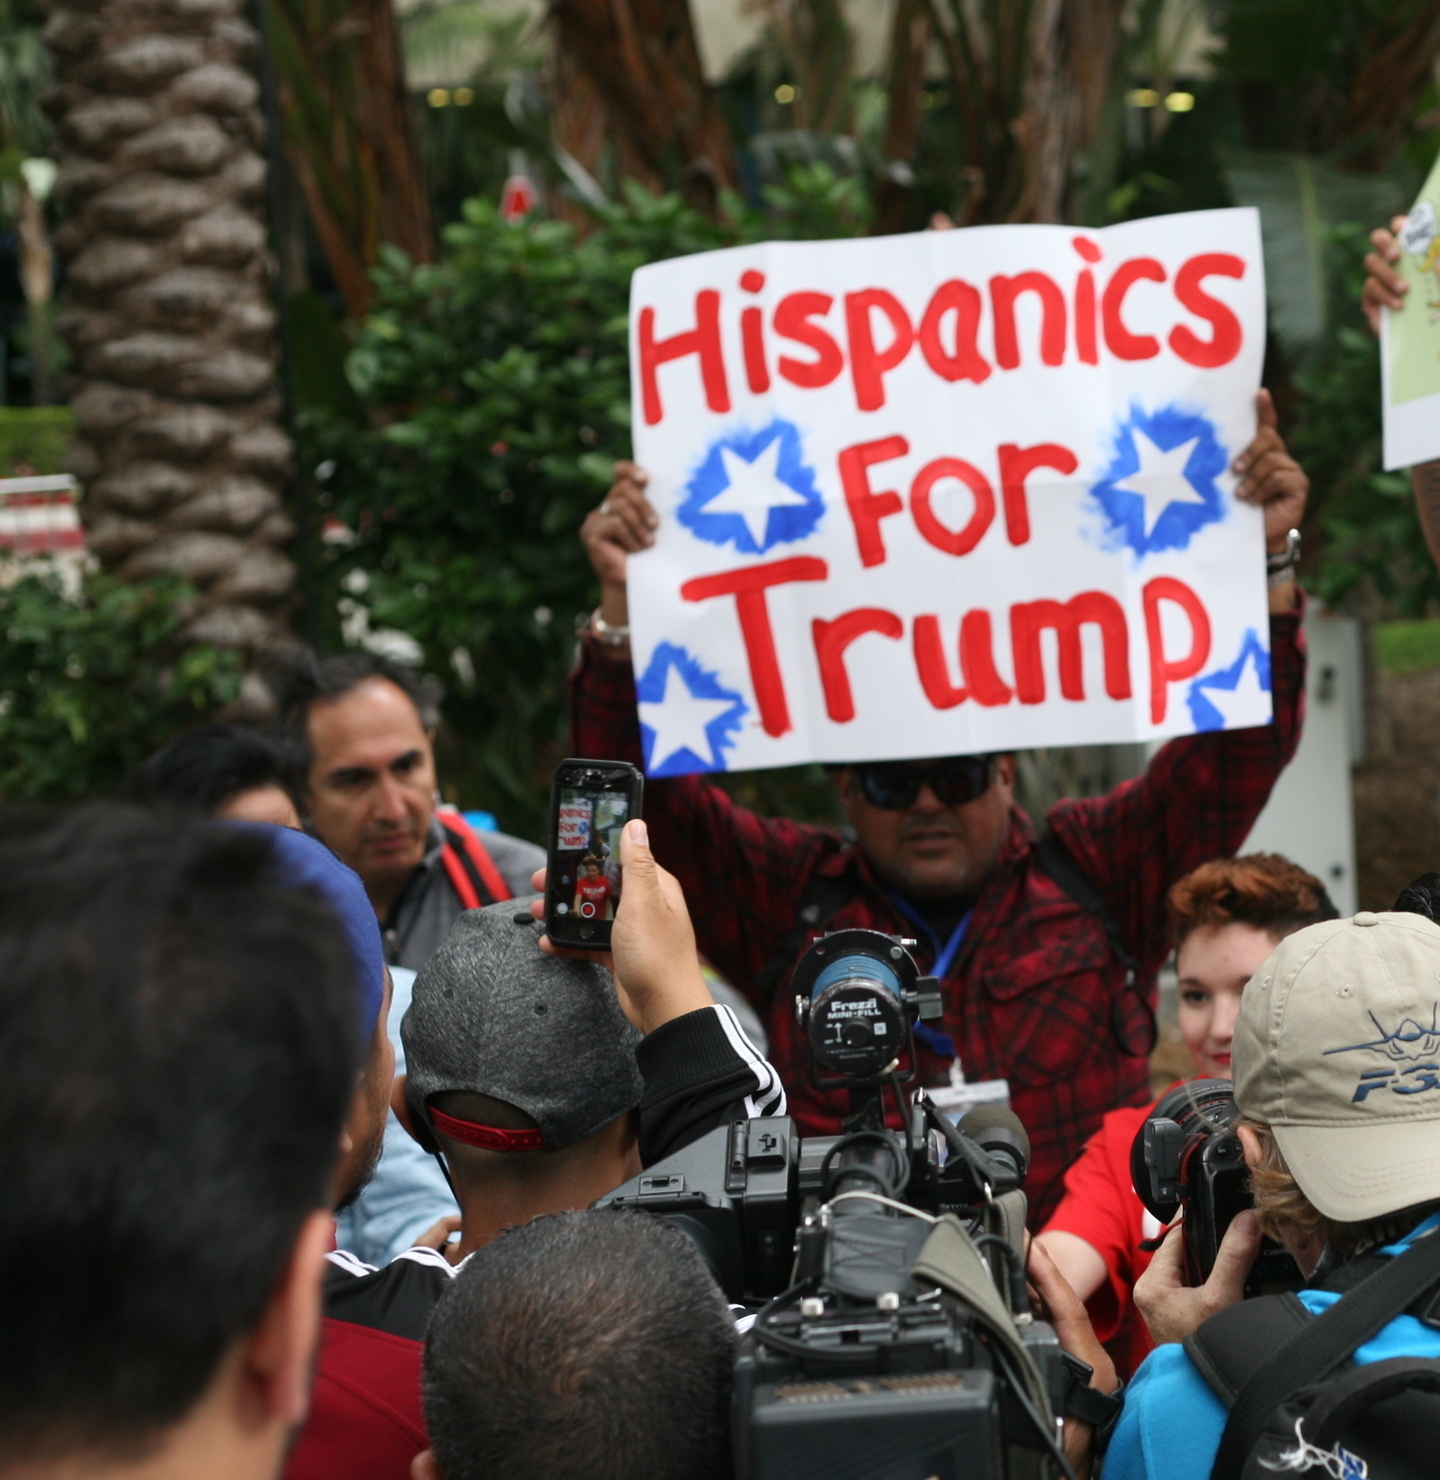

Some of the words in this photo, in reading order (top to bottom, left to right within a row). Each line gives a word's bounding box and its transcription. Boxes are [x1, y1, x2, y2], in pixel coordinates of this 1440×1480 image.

[637, 235, 1247, 426] Hispanics
[837, 434, 1080, 569] For
[679, 555, 1213, 739] Trump
[827, 1008, 881, 1019] MINI-FILL
[831, 998, 877, 1011] Frezzi
